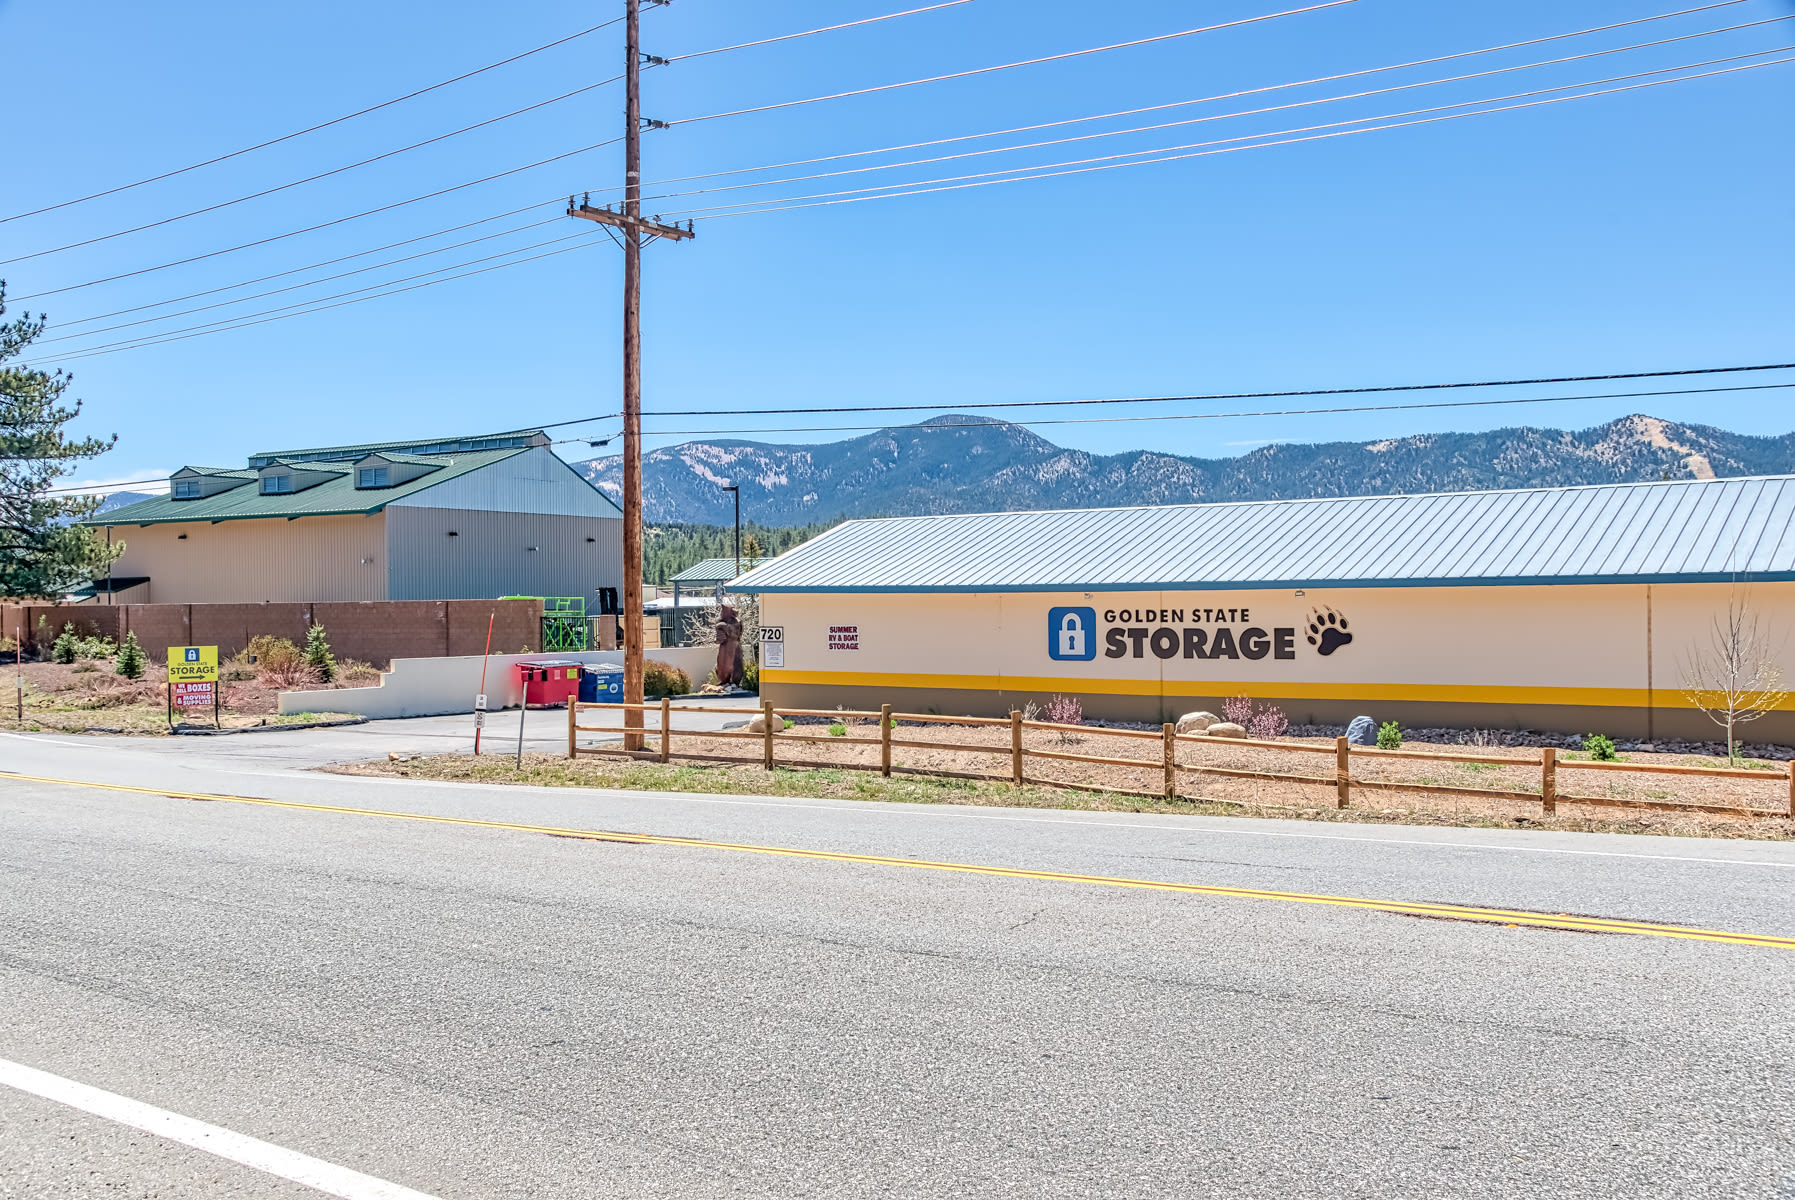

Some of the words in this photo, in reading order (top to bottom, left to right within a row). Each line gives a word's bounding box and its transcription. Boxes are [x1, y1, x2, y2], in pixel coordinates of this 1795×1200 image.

[1104, 609, 1184, 623] GOLDEN
[1191, 608, 1250, 623] STATE
[760, 628, 781, 640] 720
[829, 626, 858, 634] SUMMER
[828, 634, 837, 642] RV
[837, 634, 842, 642] &
[843, 634, 859, 642] BOAT
[828, 642, 859, 650] STORAGE
[1104, 627, 1296, 661] STORAGE
[170, 666, 214, 674] STORAGE
[187, 684, 211, 692] BOXES
